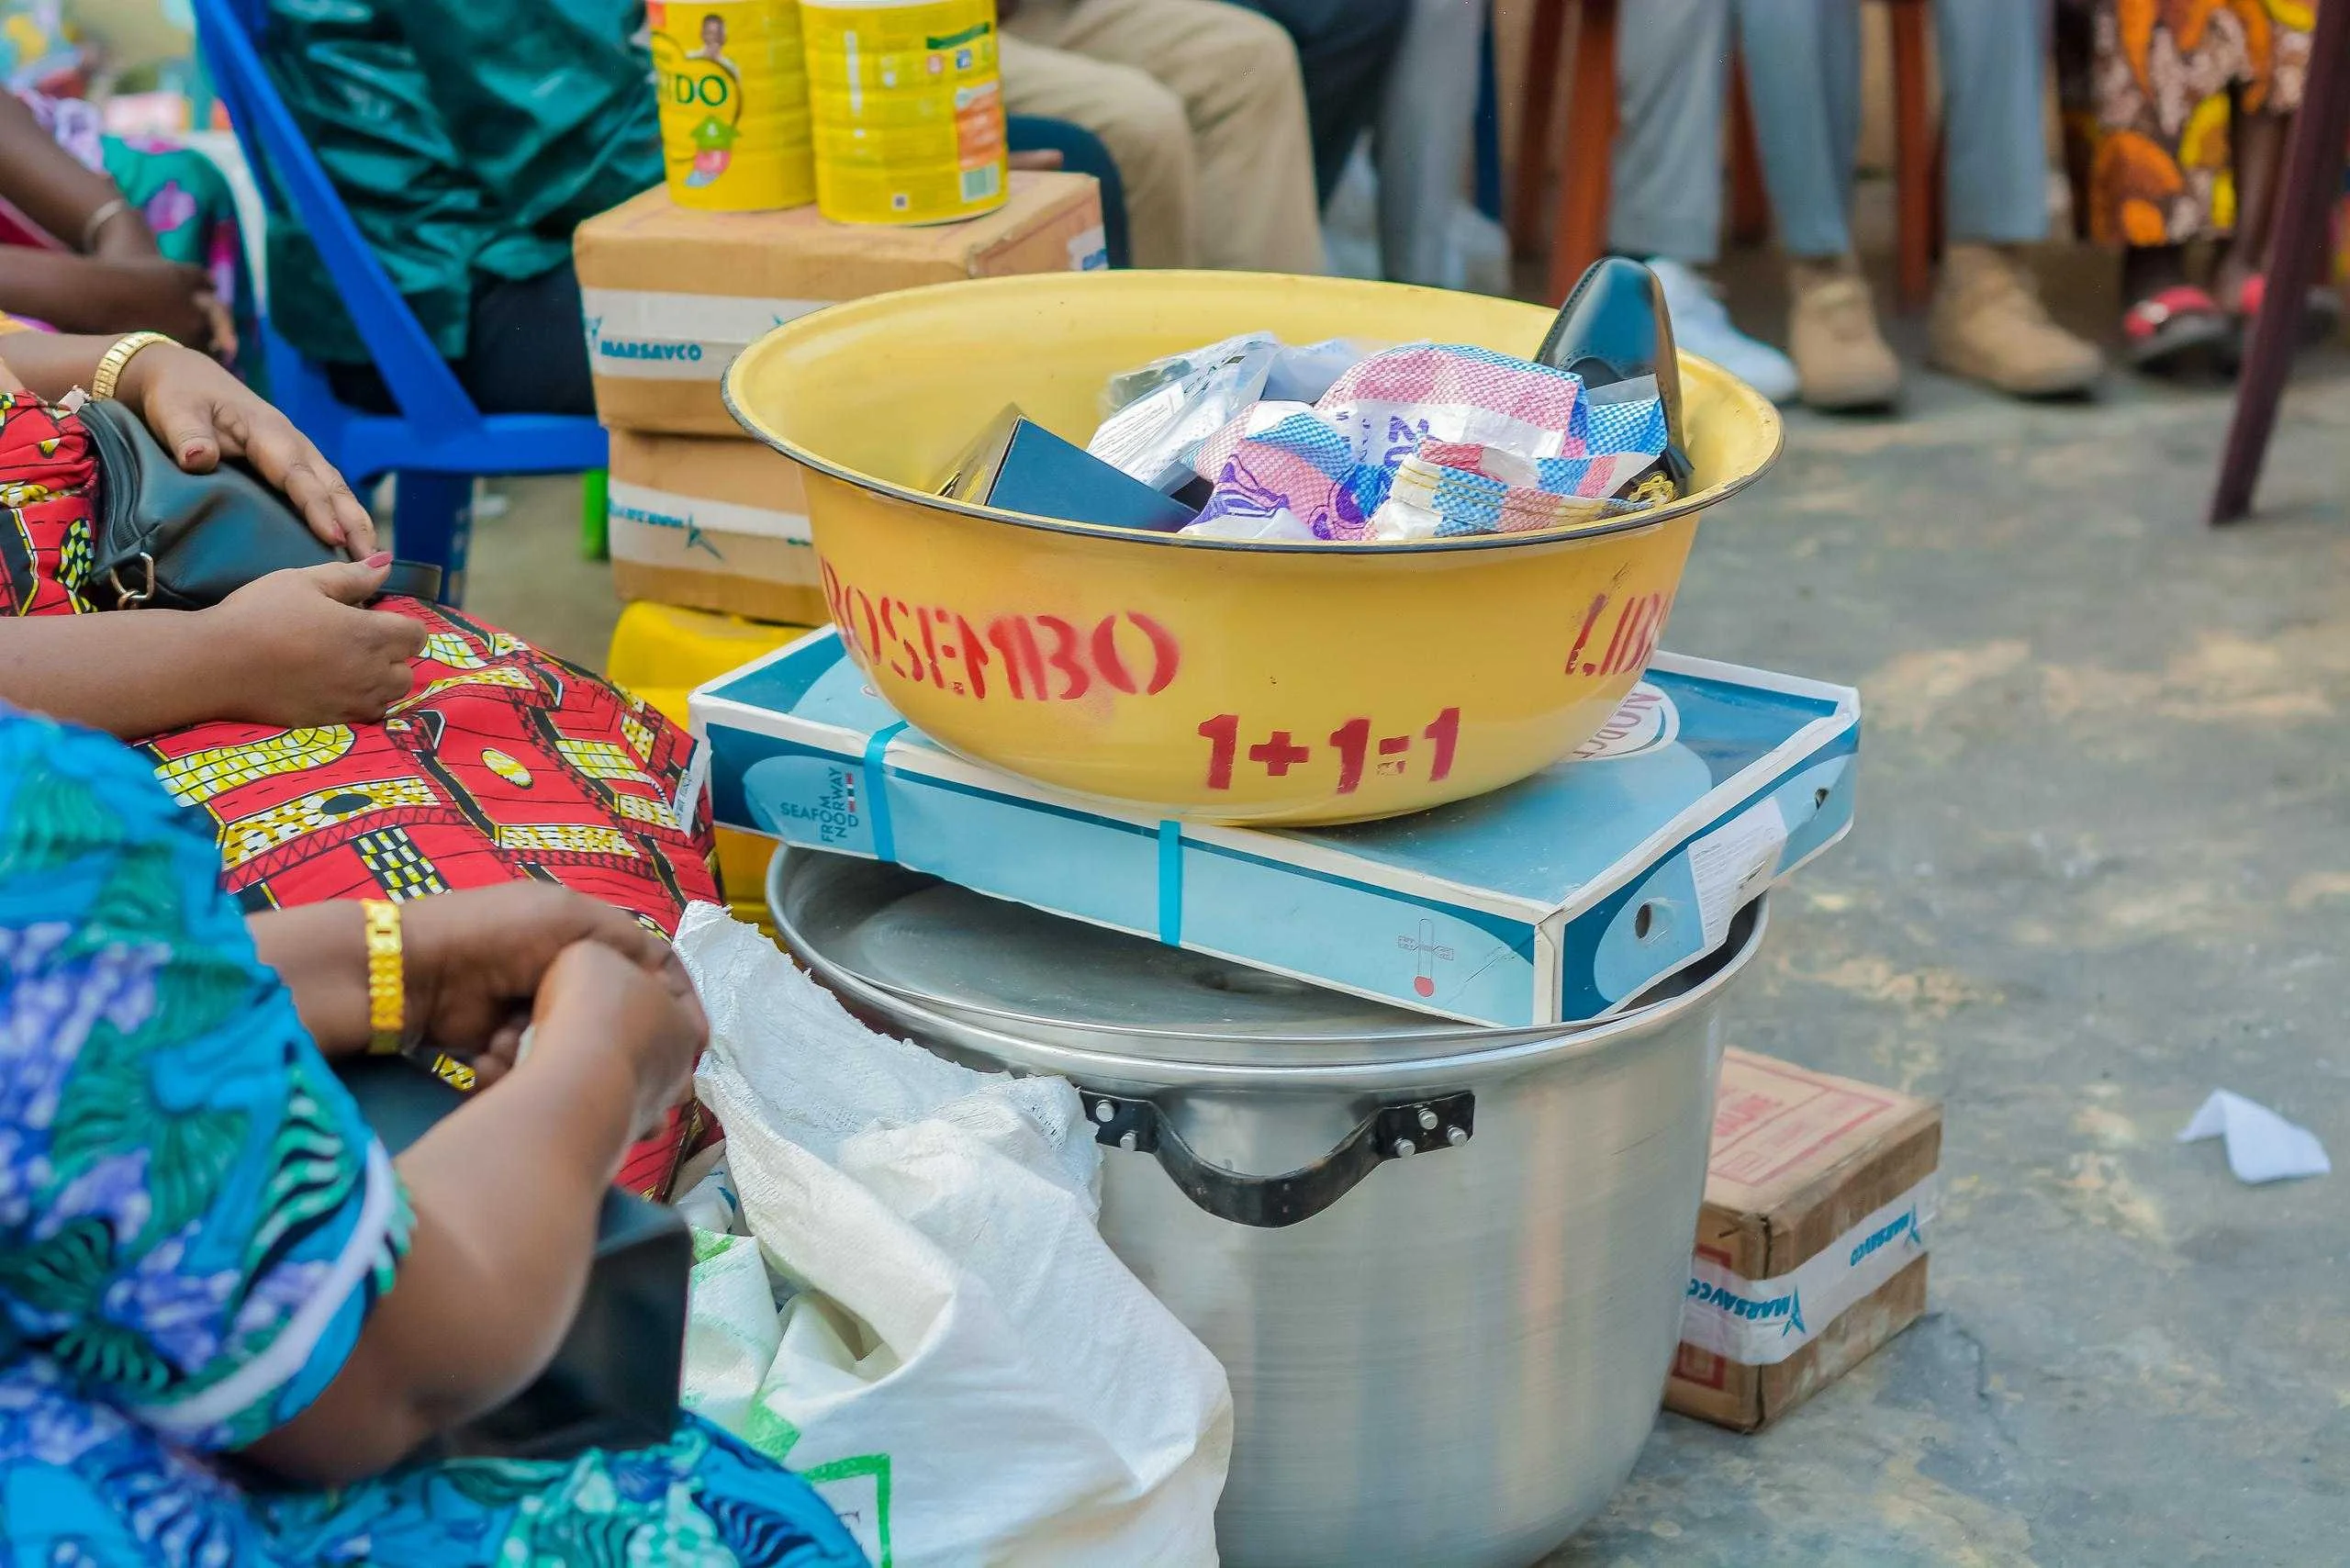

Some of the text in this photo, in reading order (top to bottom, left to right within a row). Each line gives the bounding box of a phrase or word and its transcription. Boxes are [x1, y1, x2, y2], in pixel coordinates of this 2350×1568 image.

[600, 340, 703, 362] MARSAVCO
[779, 801, 859, 828] SEAFOOD
[818, 795, 834, 843] FROM
[828, 766, 848, 839] NORWAY
